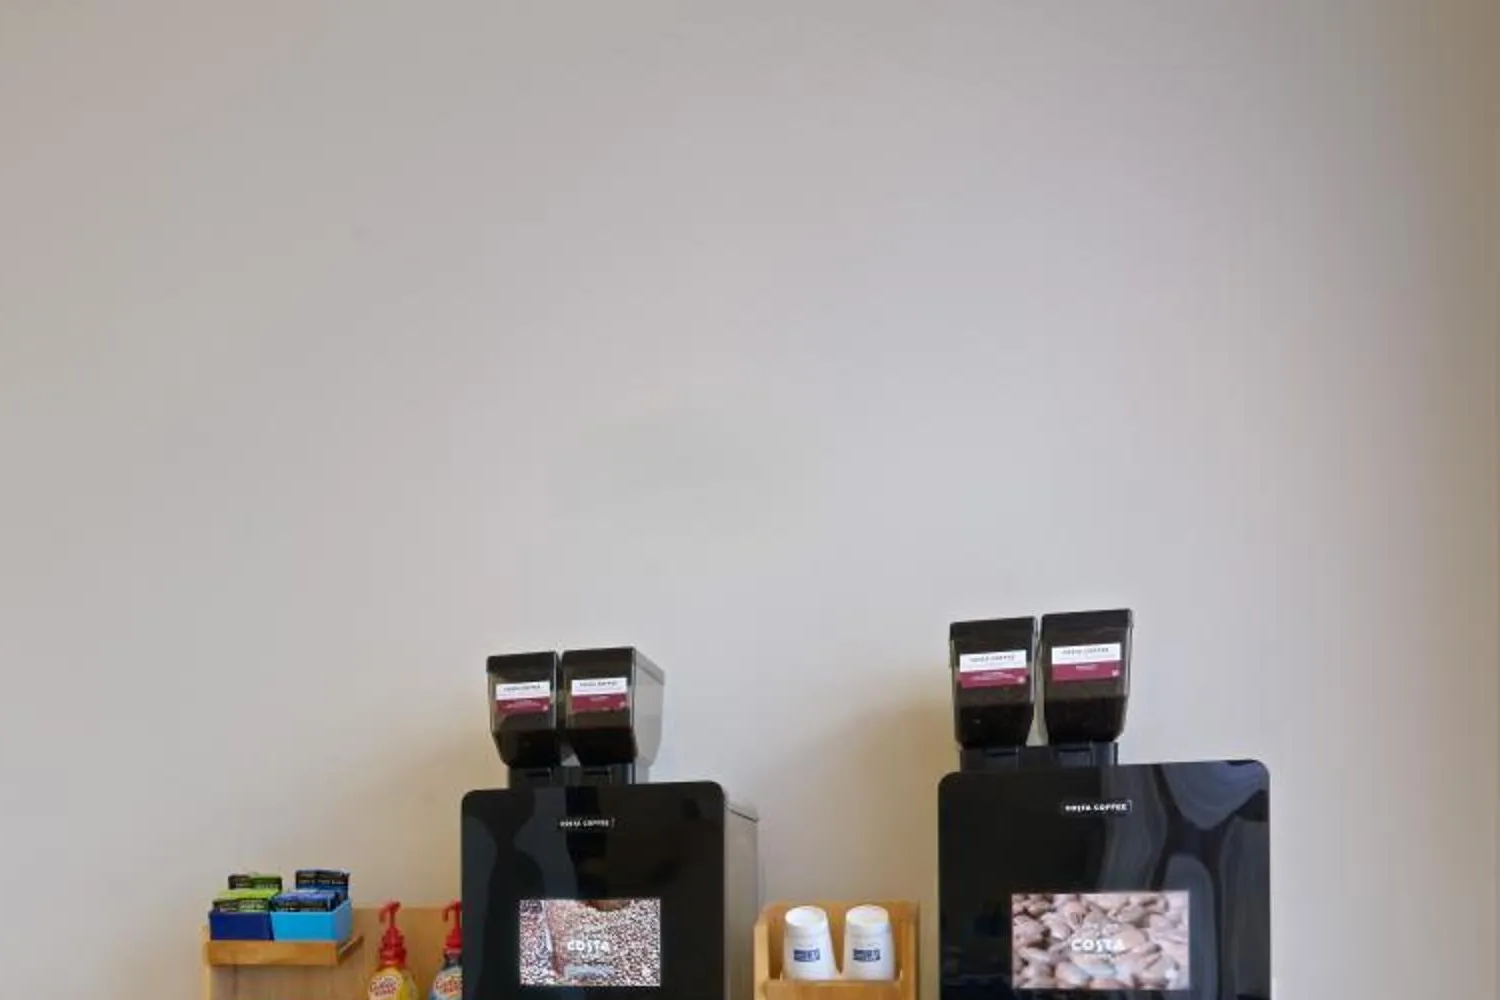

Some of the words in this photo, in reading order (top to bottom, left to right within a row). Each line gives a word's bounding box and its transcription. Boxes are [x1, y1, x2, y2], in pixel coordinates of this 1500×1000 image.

[1093, 803, 1128, 811] COFFEE
[567, 939, 610, 953] COSTA
[1071, 939, 1126, 953] COSTA
